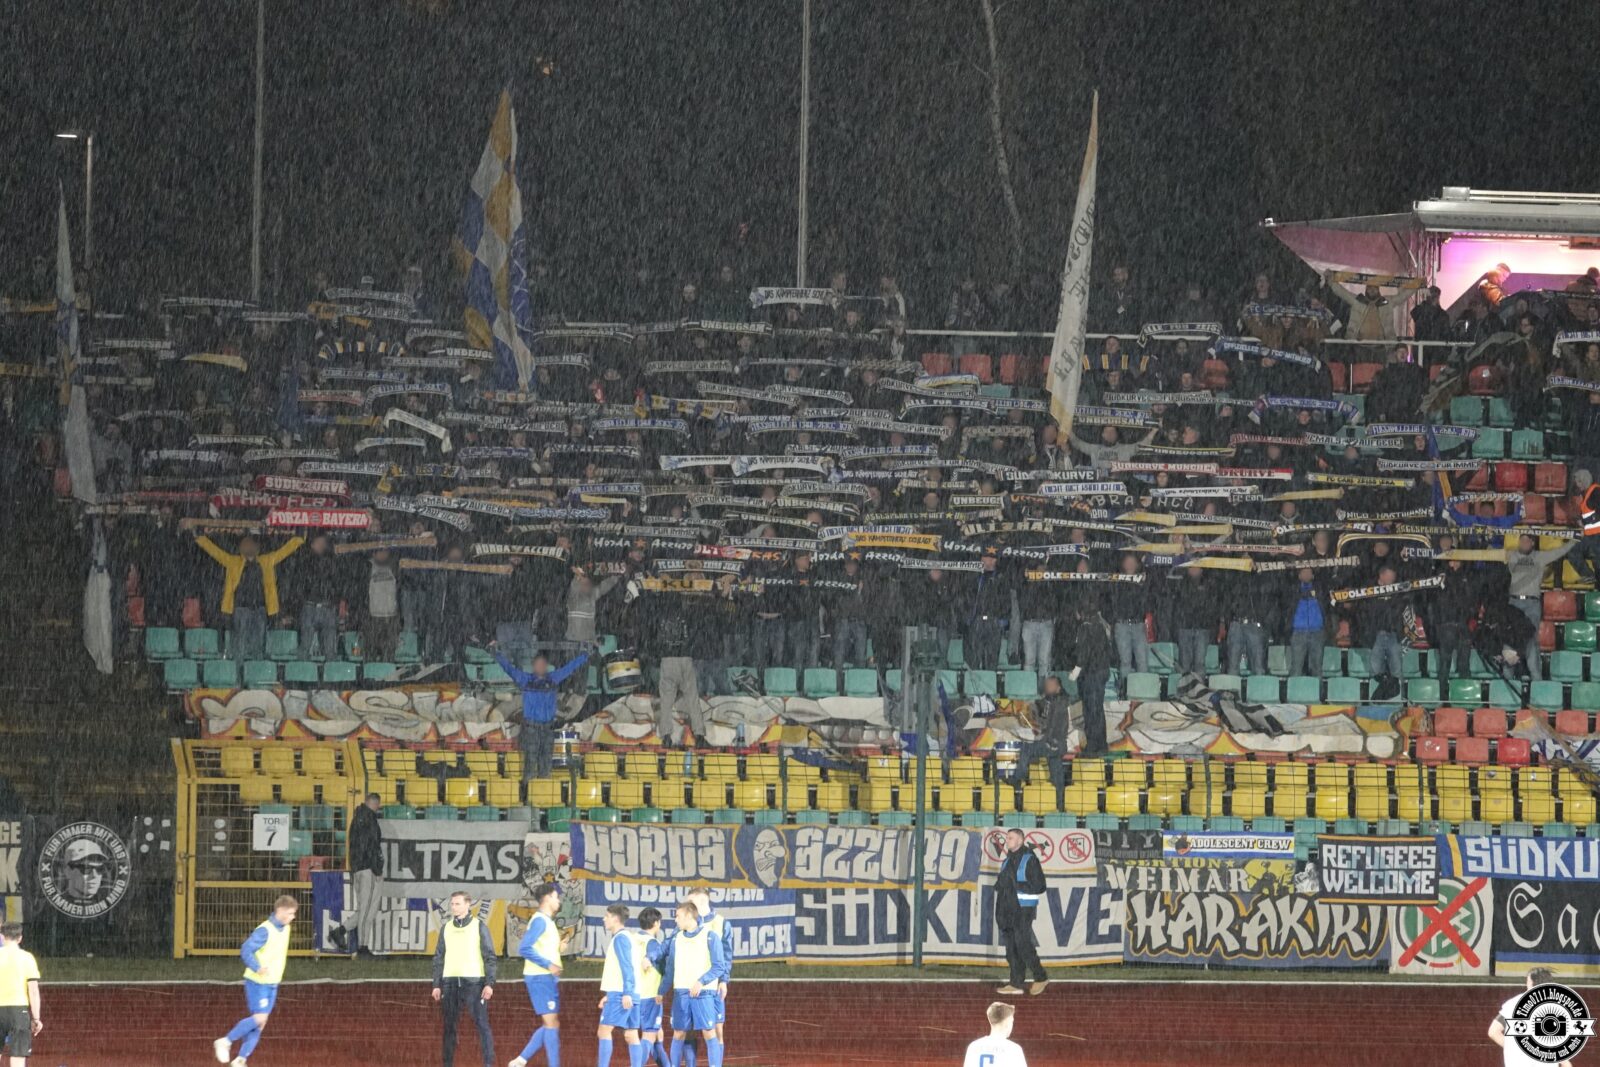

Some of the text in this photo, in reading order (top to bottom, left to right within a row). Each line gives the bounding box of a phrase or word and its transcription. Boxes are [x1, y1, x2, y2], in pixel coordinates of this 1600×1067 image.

[271, 511, 369, 526] FORZA BAYERN
[263, 817, 281, 825] TOR
[59, 824, 92, 841] IMMER
[94, 827, 113, 842] MIT
[110, 838, 127, 860] UNS
[1190, 838, 1291, 850] ADOLESCENT CREW
[1322, 843, 1437, 870] REFUGEES
[1464, 836, 1600, 879] SÜDKU
[1105, 864, 1251, 894] WEIMAR
[1322, 867, 1436, 895] WELCOME
[84, 900, 109, 916] IRON
[105, 879, 126, 905] MIND
[794, 887, 1123, 948] SÜDKUVE
[1130, 892, 1383, 952] HARAKIRI
